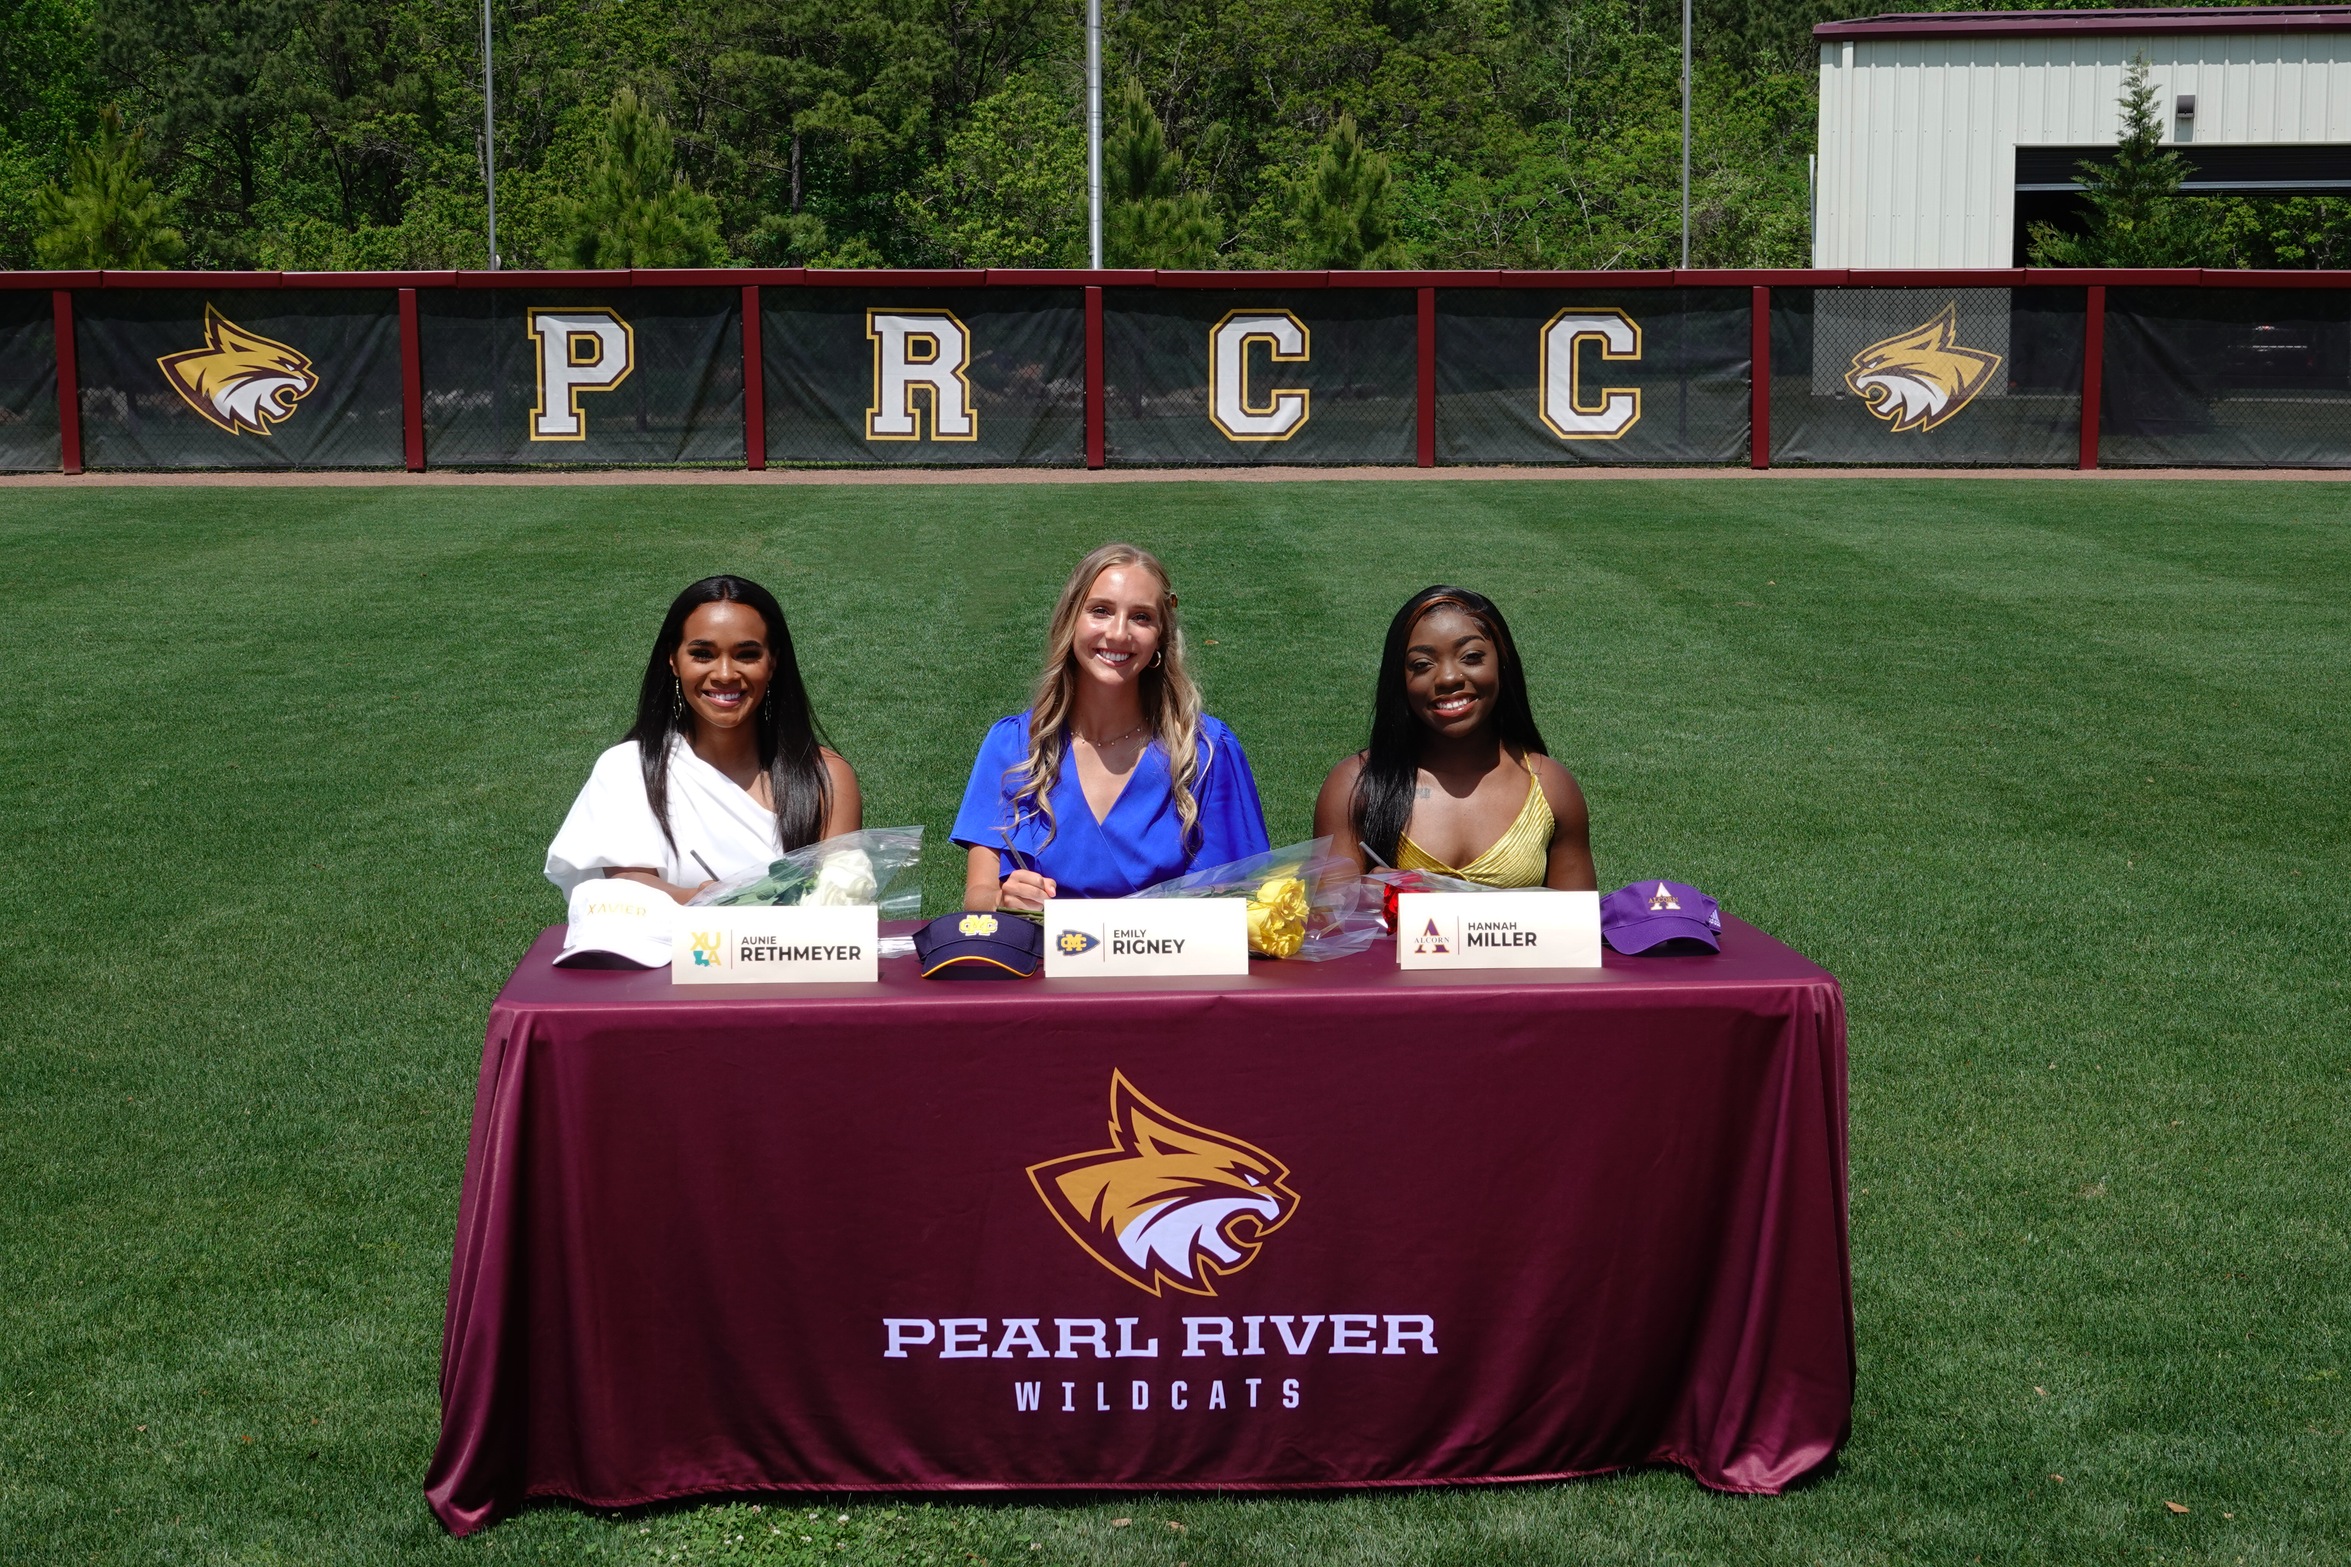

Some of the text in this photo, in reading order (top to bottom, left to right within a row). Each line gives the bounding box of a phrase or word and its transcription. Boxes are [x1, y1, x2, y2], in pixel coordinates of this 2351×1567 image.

[528, 307, 1641, 441] P R C C
[1113, 929, 1147, 938] EMILY
[1468, 922, 1517, 930] HANNAH
[741, 936, 777, 945] AUNIE
[1113, 939, 1186, 954] RIGNEY
[1467, 932, 1537, 947] MILLER
[740, 946, 861, 962] RETHMEYER
[883, 1314, 1439, 1359] PEARL RIVER
[1014, 1378, 1300, 1412] WILDCATS
